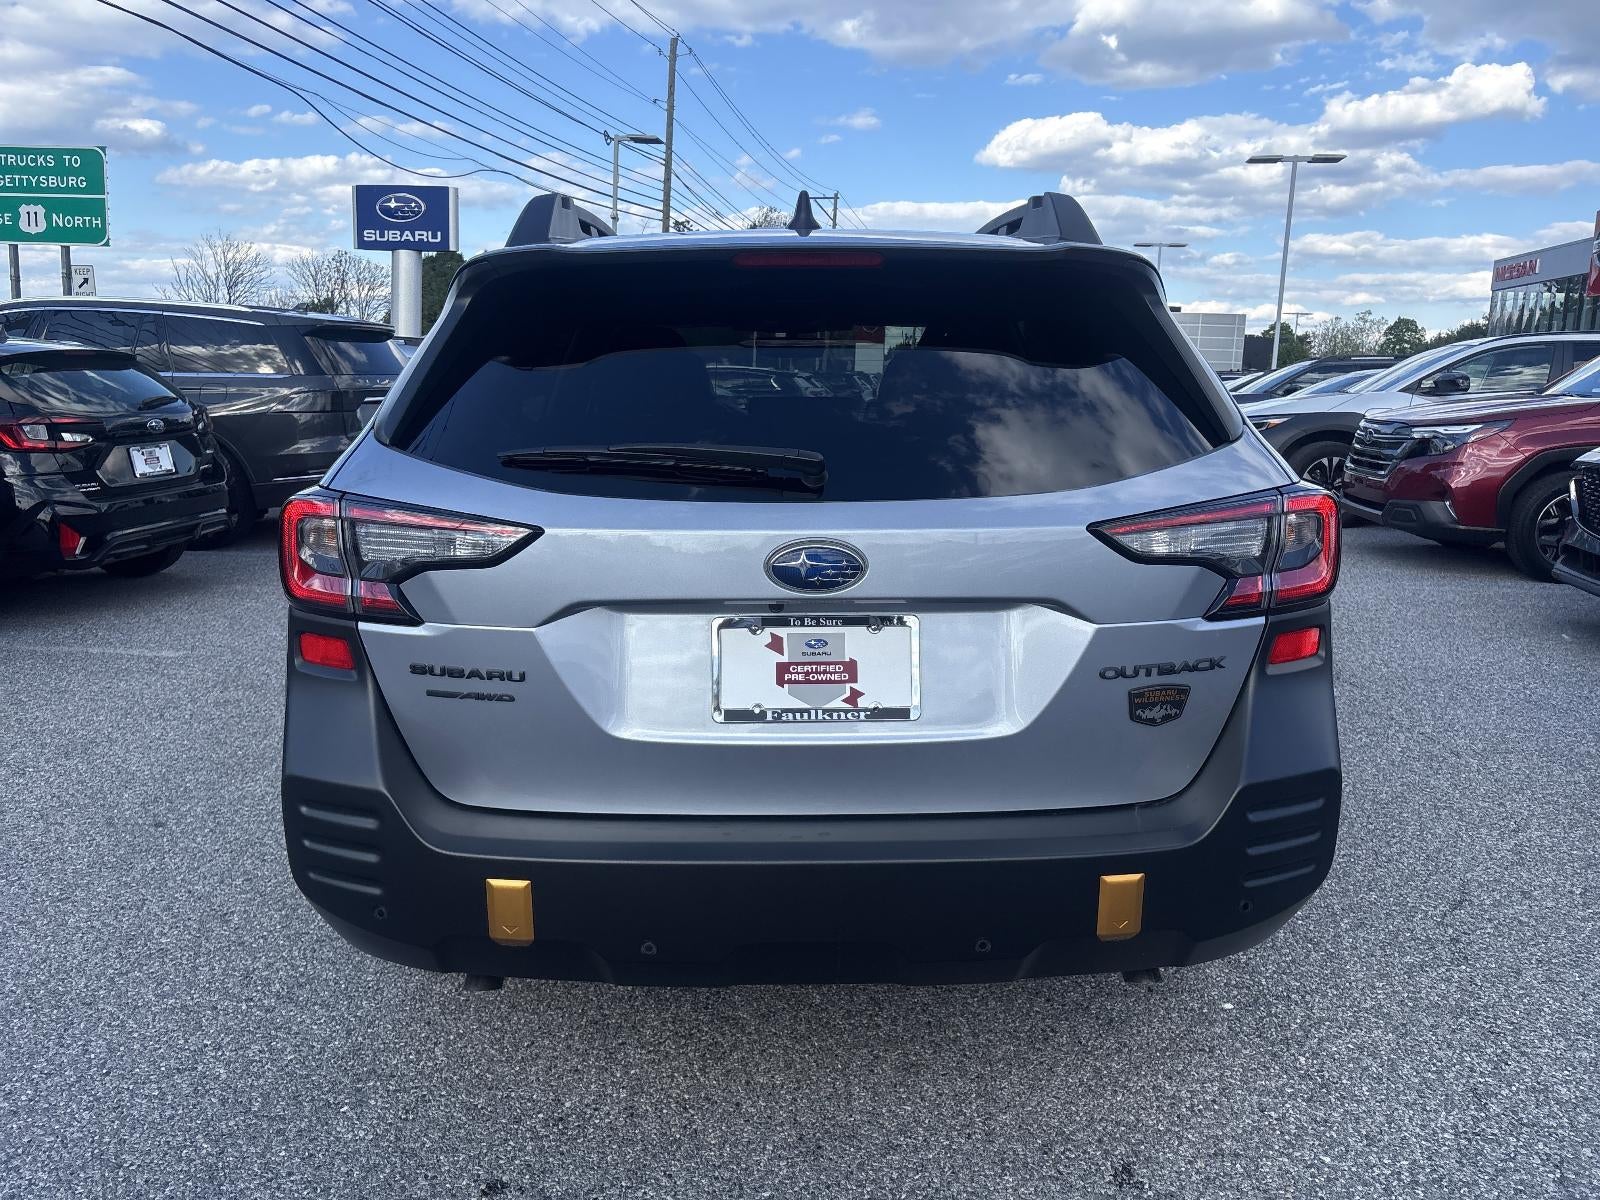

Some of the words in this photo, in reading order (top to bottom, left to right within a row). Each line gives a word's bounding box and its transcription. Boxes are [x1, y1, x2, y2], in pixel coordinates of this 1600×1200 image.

[0, 154, 55, 167] TRUCKS
[63, 155, 81, 168] TO
[26, 211, 39, 227] 11
[52, 213, 102, 229] NORTH
[363, 229, 441, 243] SUBARU
[74, 268, 91, 276] KEEP
[788, 617, 801, 627] To
[804, 617, 817, 627] Be
[409, 663, 526, 682] SUBARU
[789, 664, 844, 673] CERTIFIED
[1098, 656, 1226, 681] OUTBACK
[784, 673, 849, 681] PRE-OWNED
[459, 691, 516, 703] AWD
[1134, 694, 1186, 704] WILDERNESS
[1144, 689, 1178, 698] SUBARU
[766, 709, 871, 721] Faulkner
